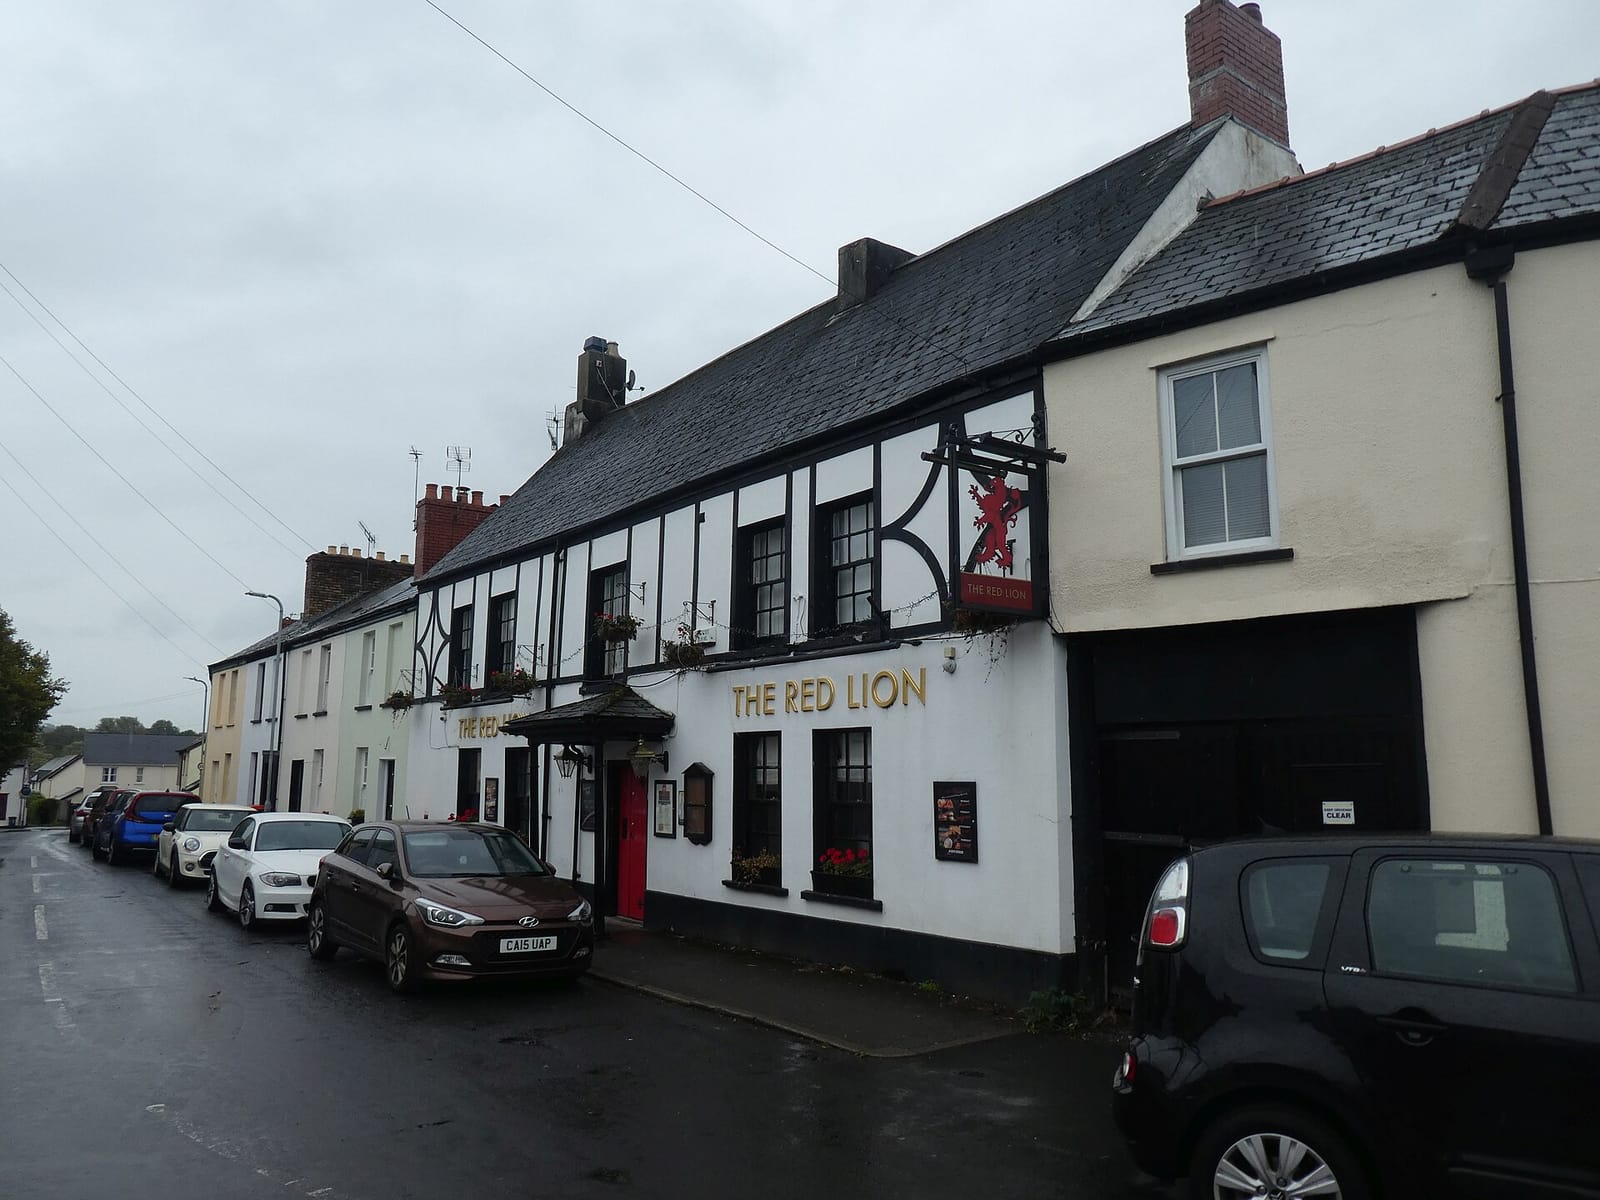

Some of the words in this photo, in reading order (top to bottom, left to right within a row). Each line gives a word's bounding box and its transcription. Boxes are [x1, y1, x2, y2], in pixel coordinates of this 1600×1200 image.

[967, 583, 984, 595] THE
[986, 585, 1003, 597] RED
[1005, 588, 1027, 600] LION
[733, 682, 777, 717] THE
[785, 676, 836, 713] RED
[848, 667, 927, 709] LION
[458, 716, 477, 739] THE
[480, 714, 499, 738] RED
[506, 940, 530, 951] CA15
[532, 938, 552, 950] UAP
